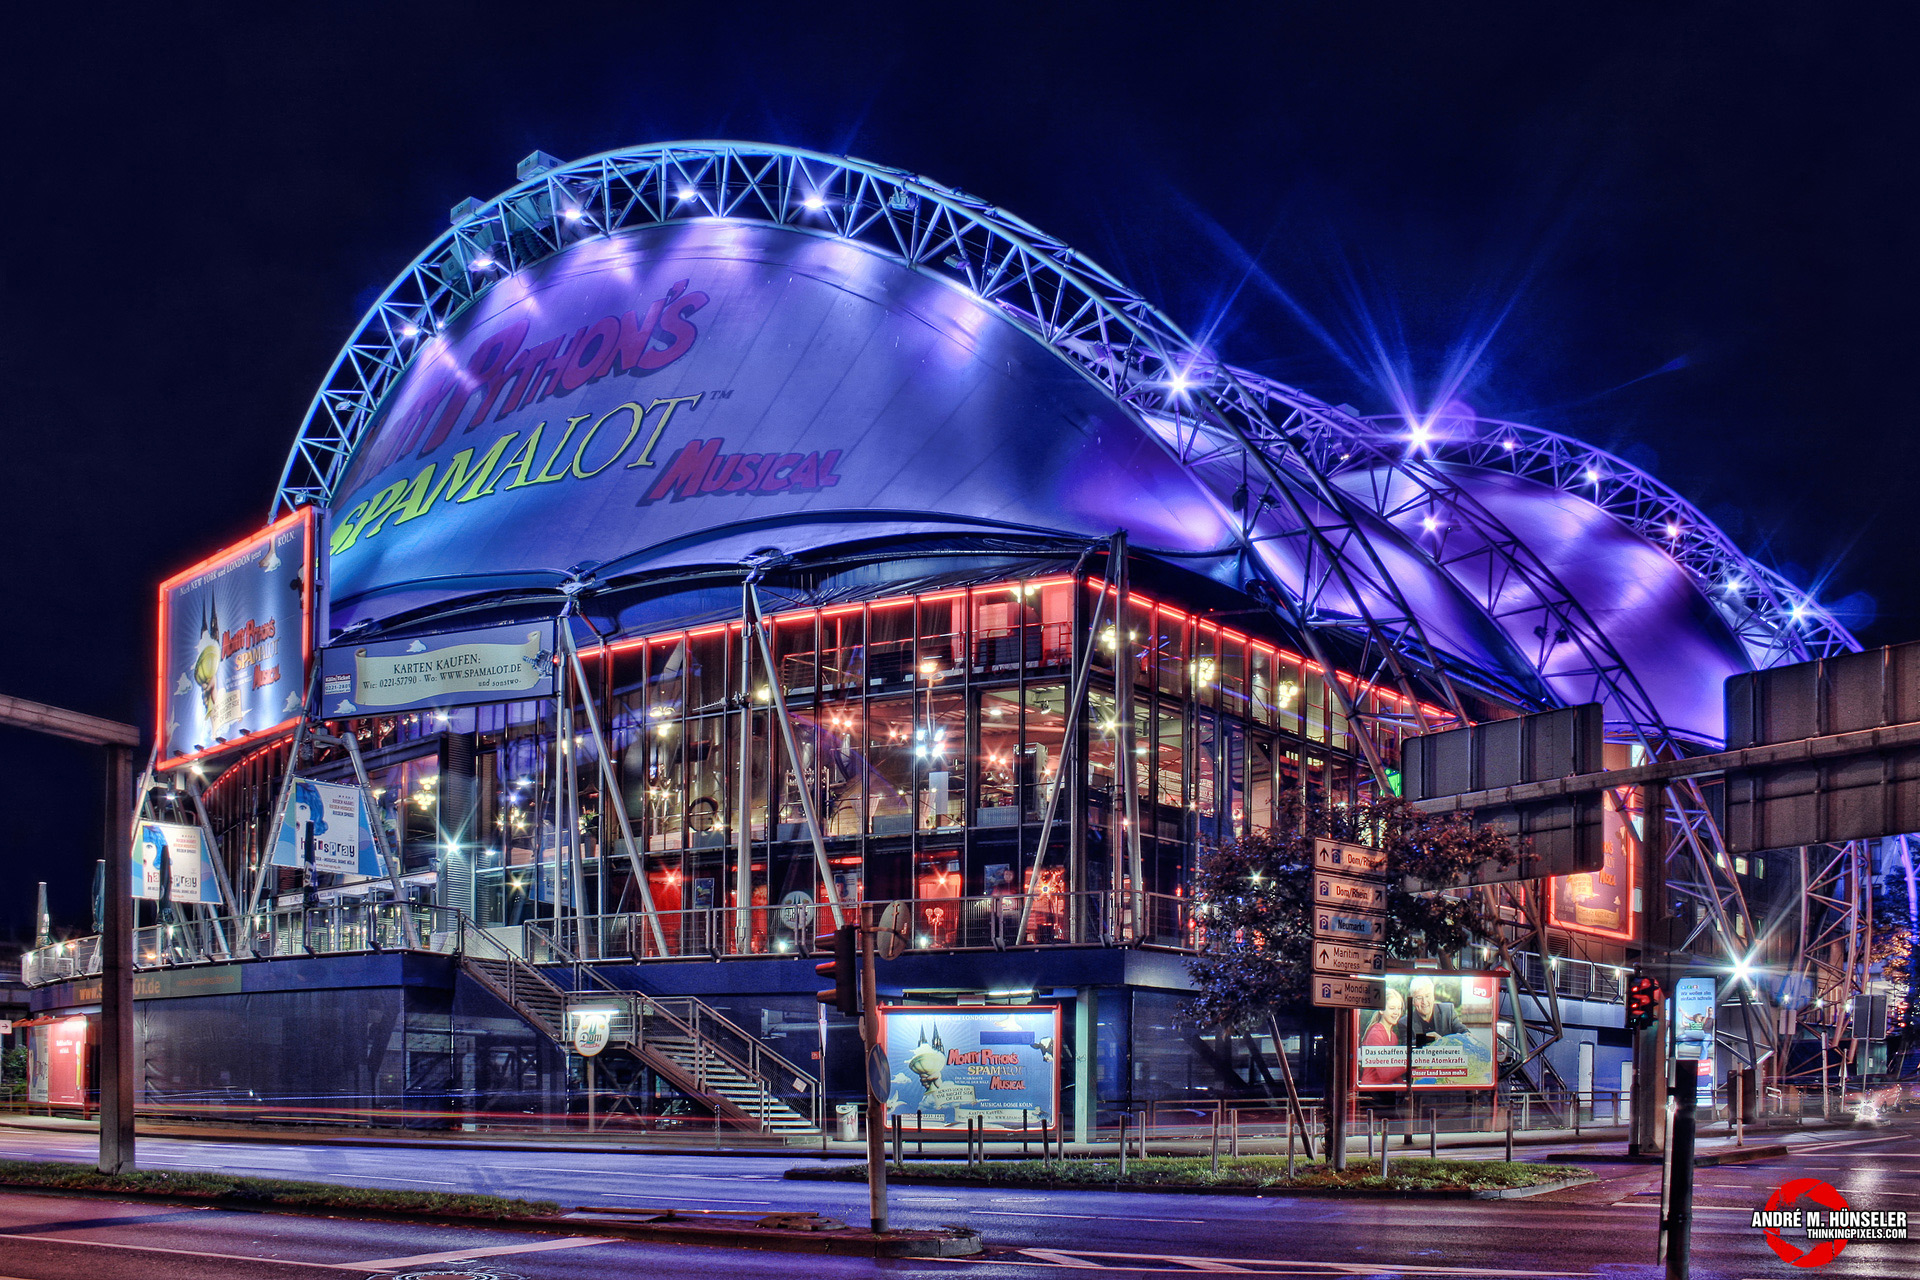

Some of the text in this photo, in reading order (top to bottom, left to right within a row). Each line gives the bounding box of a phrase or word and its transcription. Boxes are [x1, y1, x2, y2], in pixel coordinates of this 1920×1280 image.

[416, 279, 711, 461] PYTHON'S
[329, 392, 702, 557] SPAMALOT
[636, 437, 843, 508] MUSICAL
[203, 569, 218, 586] YORK
[226, 553, 251, 574] LONDON
[235, 638, 281, 672] SPAMALOT
[394, 653, 482, 675] KARTEN KAUFEN:
[379, 675, 418, 689] 0221-57790
[439, 663, 522, 681] WWW.SPAMALOT.DE
[478, 678, 492, 688] und
[300, 836, 355, 858] hirspray
[1336, 885, 1368, 900] Dom/Rhein
[1337, 919, 1366, 933] Neumarkt
[1333, 946, 1360, 960] Maritim
[1333, 958, 1361, 971] Kongress
[1344, 982, 1371, 996] Mondial
[1473, 987, 1487, 997] SPD
[1344, 993, 1371, 1005] Kongress
[947, 1048, 1019, 1065] MONTY PYTHON'S
[1365, 1048, 1377, 1056] Das
[1377, 1048, 1402, 1056] schaffen
[1414, 1057, 1430, 1065] ohne
[1431, 1057, 1466, 1065] Atomkraft.
[967, 1065, 1024, 1076] SPAMALOT
[989, 1075, 1027, 1090] MUSICAL
